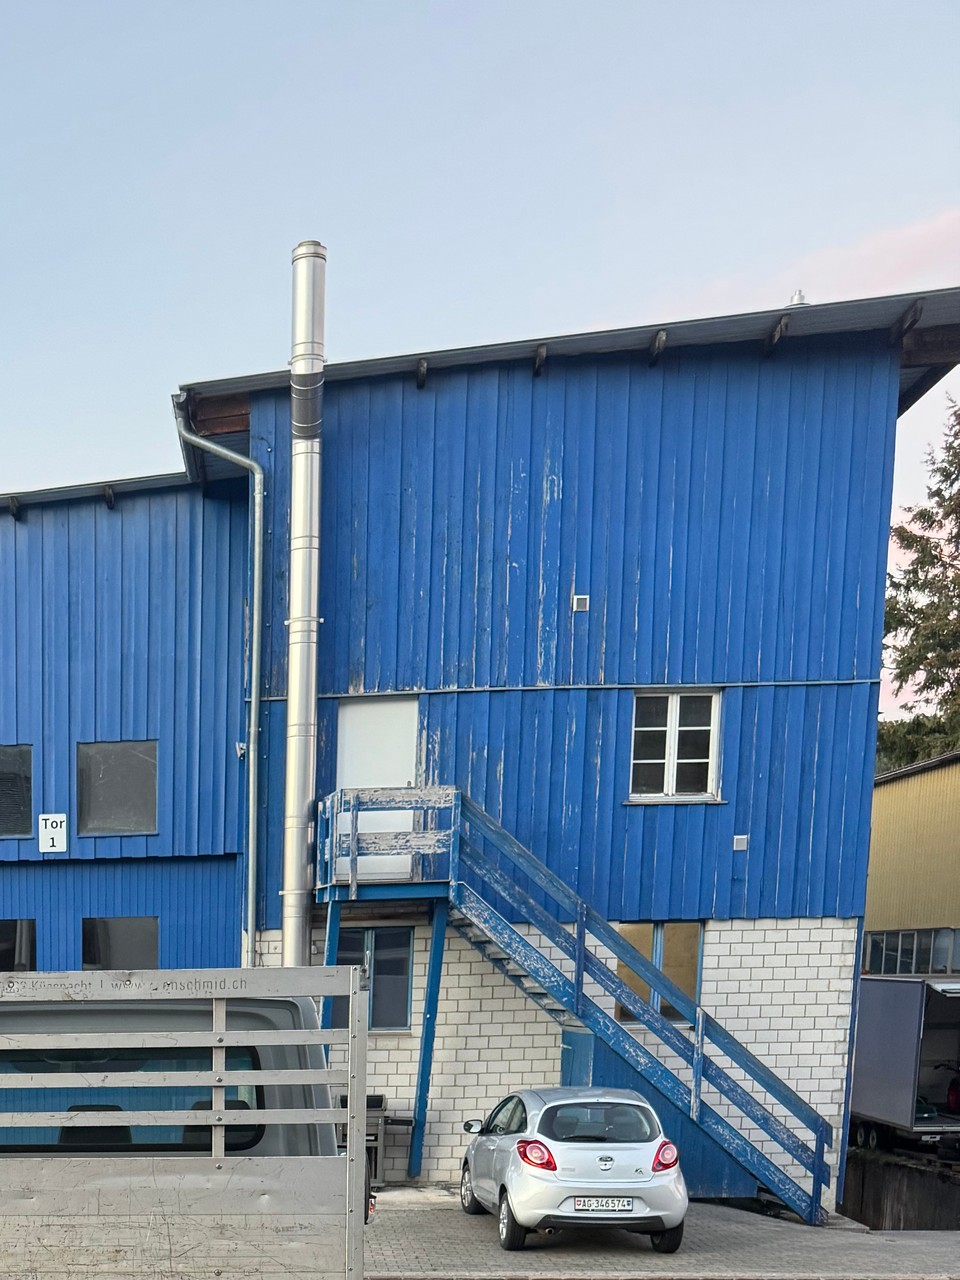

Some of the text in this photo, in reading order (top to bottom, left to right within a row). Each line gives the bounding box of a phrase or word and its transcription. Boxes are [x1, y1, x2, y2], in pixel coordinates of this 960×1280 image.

[42, 818, 65, 829] Tor
[49, 837, 57, 848] 1
[111, 978, 247, 990] wwwenschmid.ch
